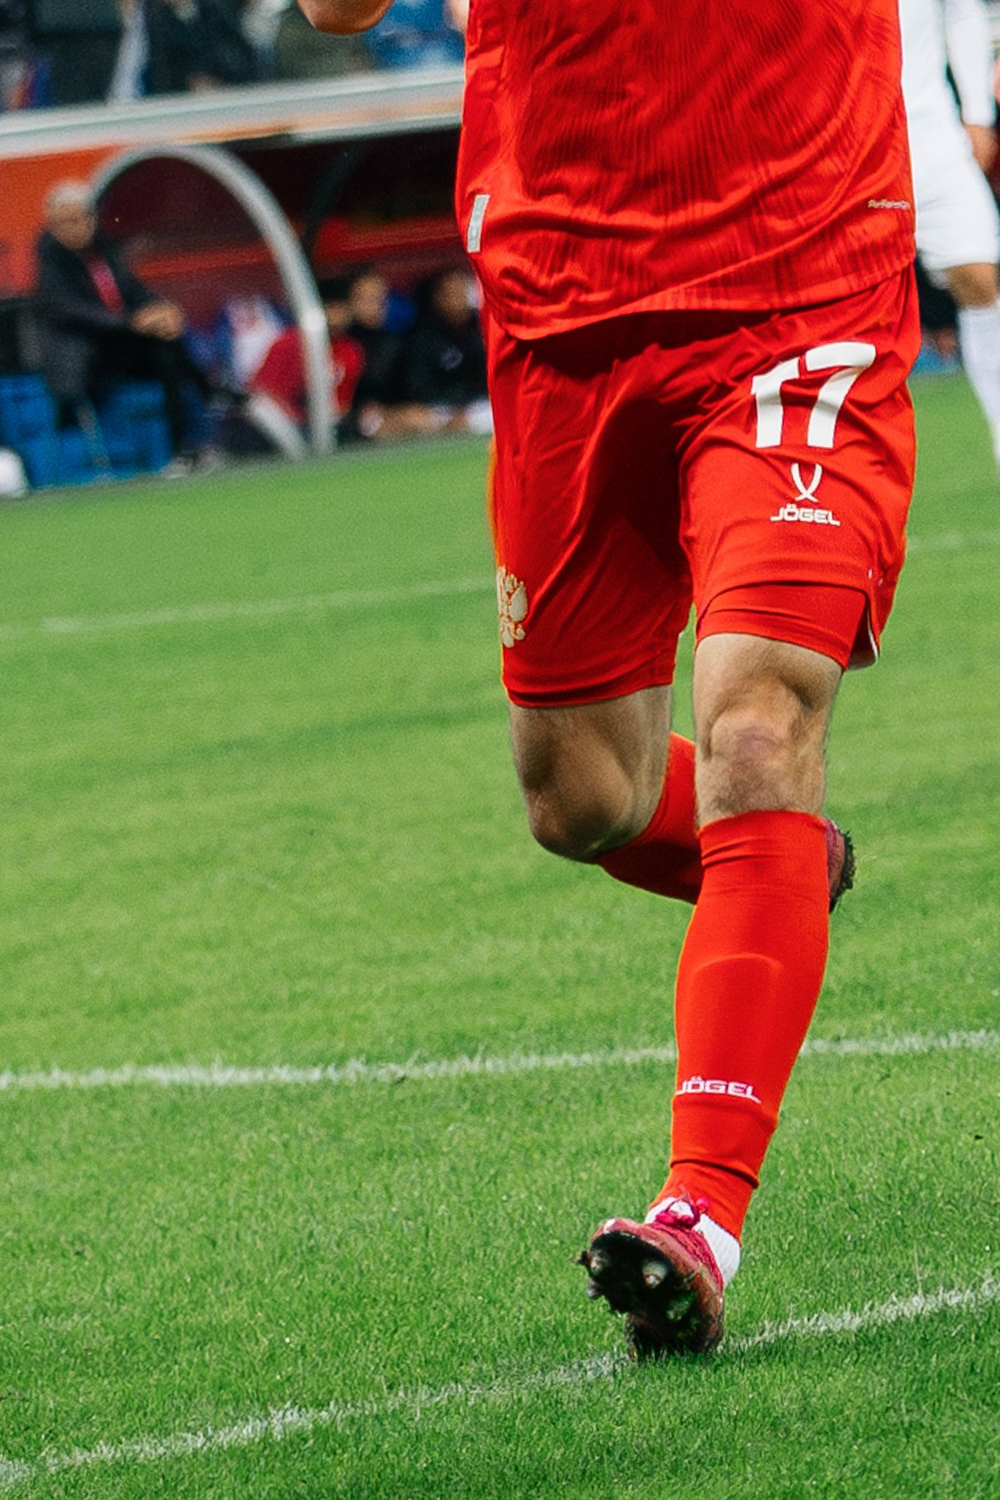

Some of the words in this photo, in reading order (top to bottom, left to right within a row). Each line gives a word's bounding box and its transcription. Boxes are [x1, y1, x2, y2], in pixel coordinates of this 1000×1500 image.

[751, 341, 876, 449] 17
[770, 503, 841, 527] JÖGEL
[675, 1075, 762, 1104] JÖGEL
